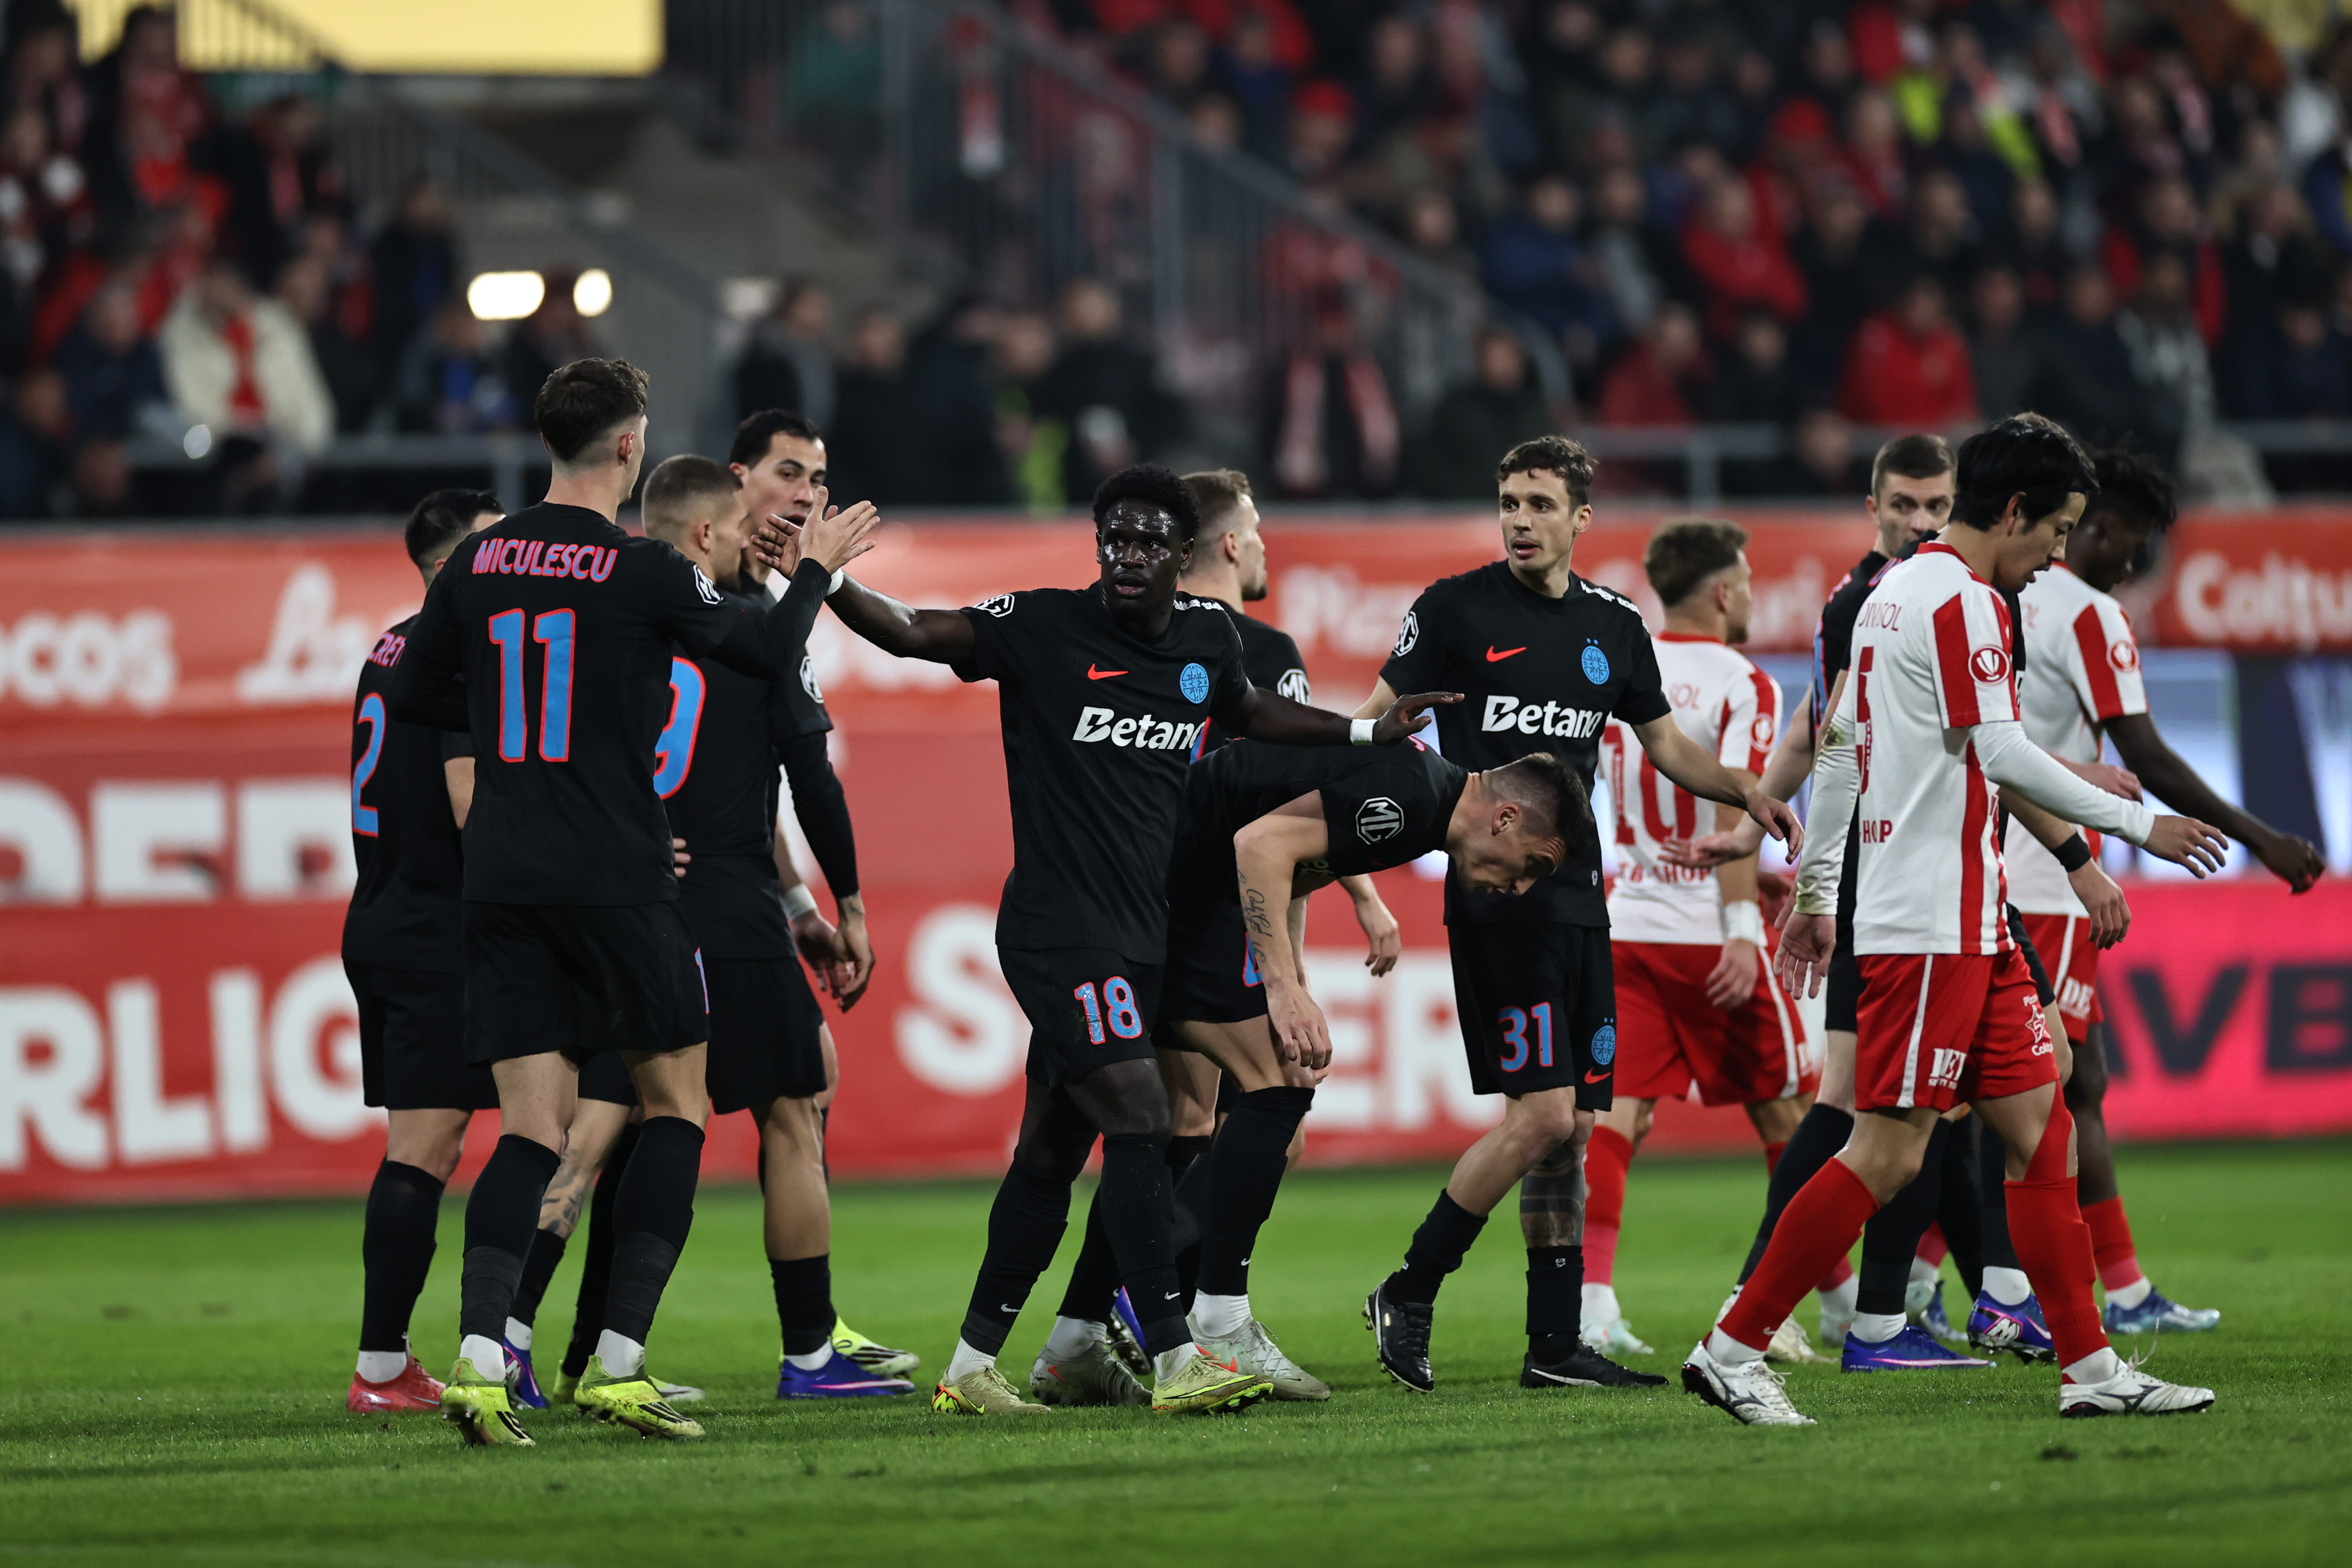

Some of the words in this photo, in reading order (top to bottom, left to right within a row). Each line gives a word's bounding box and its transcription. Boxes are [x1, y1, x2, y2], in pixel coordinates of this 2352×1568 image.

[472, 538, 618, 583] MICULESCU
[488, 608, 576, 762] 11
[1481, 695, 1603, 739] Betano
[351, 692, 386, 839] 2
[1603, 724, 1696, 846] 10
[1360, 801, 1400, 842] MG
[1859, 820, 1893, 844] HOP
[1074, 975, 1143, 1044] 18
[1497, 1002, 1553, 1073] 31
